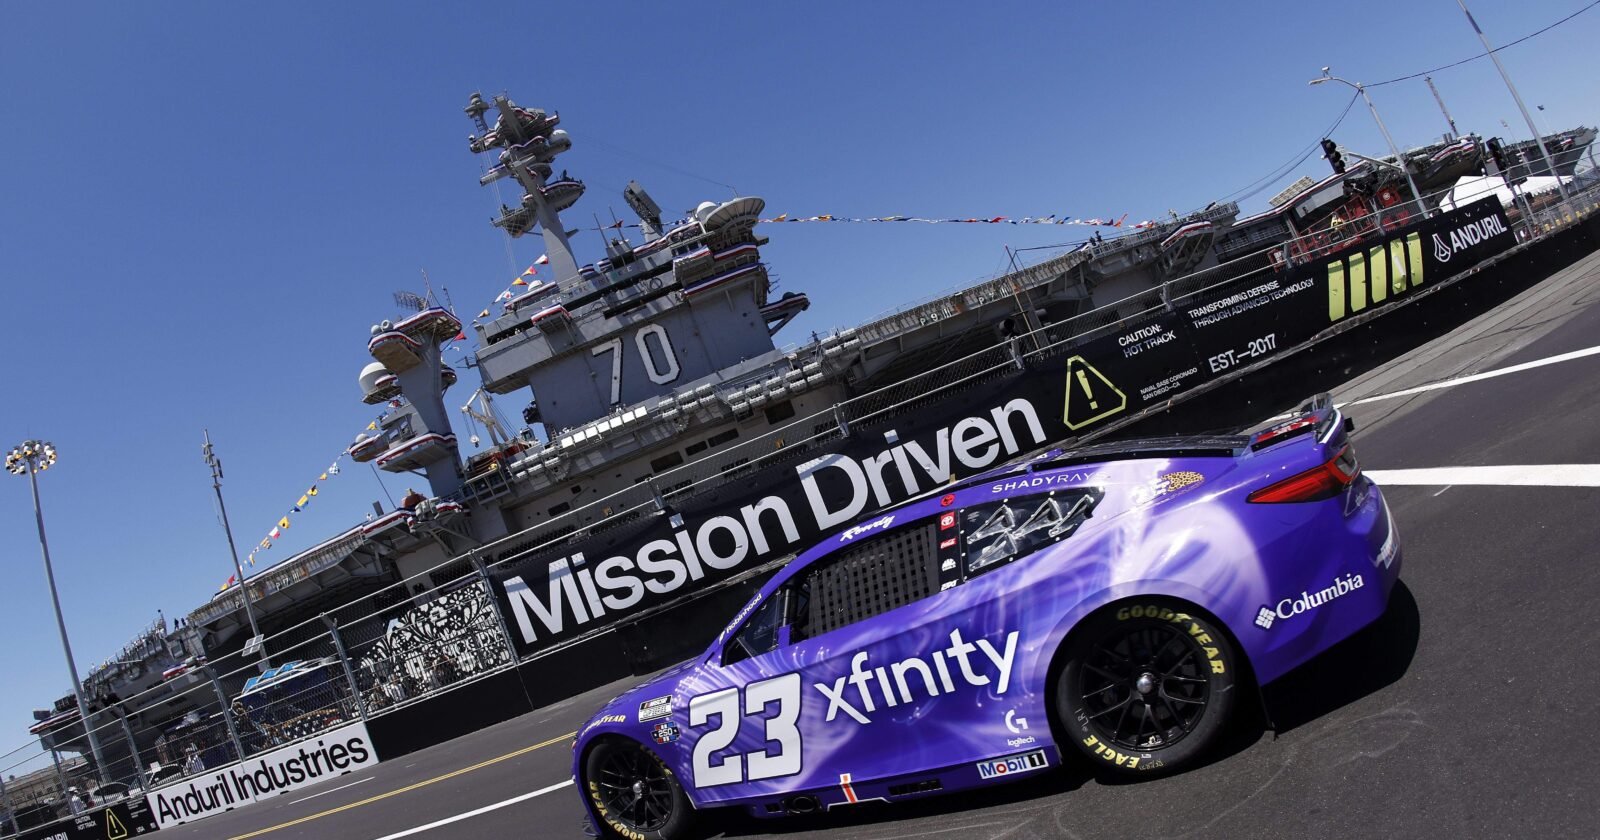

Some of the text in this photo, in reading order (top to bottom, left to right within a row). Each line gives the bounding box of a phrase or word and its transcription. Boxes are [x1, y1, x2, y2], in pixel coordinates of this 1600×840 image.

[1450, 214, 1508, 254] ANDURIL
[1188, 280, 1280, 319] TRANSFORMING DEFENSE
[1192, 277, 1315, 329] THROUGH ADVANCED TECHNOLOGY
[1118, 323, 1163, 347] CAUTION:
[1123, 330, 1177, 359] HOT TRACK
[592, 323, 681, 404] 70
[1140, 367, 1198, 395] NAVAL BASE CORONADO
[1142, 391, 1154, 401] SAN
[991, 471, 1108, 494] SHADYRAY
[503, 398, 1047, 644] Mission Driven
[840, 514, 896, 542] Rowdy
[726, 593, 762, 634] Robinhood
[1276, 573, 1365, 620] Columbia
[813, 628, 1020, 724] xfinity
[658, 727, 673, 739] 250
[689, 672, 802, 789] 23
[1007, 735, 1036, 748] logitech
[978, 752, 1045, 779] Mobil 1
[1083, 734, 1140, 769] EAGLE
[155, 774, 234, 824] Anduril
[232, 737, 369, 801] Industries
